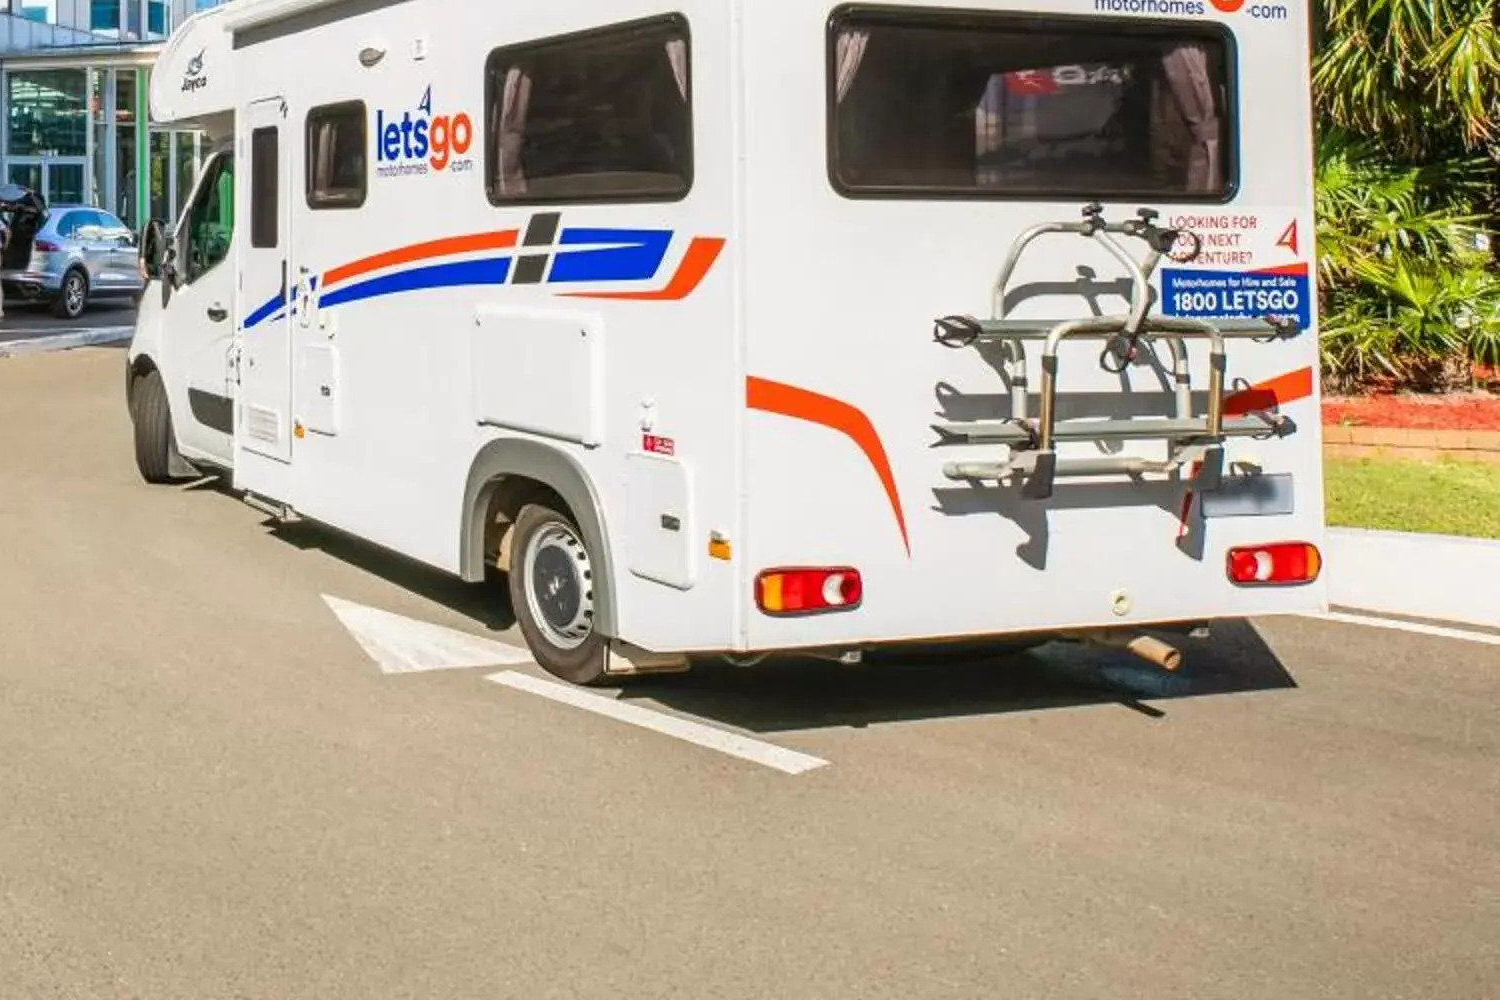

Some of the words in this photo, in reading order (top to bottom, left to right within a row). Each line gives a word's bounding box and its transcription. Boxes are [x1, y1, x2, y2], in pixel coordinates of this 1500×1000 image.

[1169, 215, 1229, 229] LOOKING
[1232, 215, 1257, 229] FOR
[1171, 233, 1205, 246] OUR
[1208, 233, 1241, 246] NEXT
[1228, 277, 1240, 287] for
[1261, 277, 1277, 287] and
[1279, 276, 1297, 287] Sale
[1173, 291, 1217, 311] 1800
[1222, 289, 1299, 311] LETSGO
